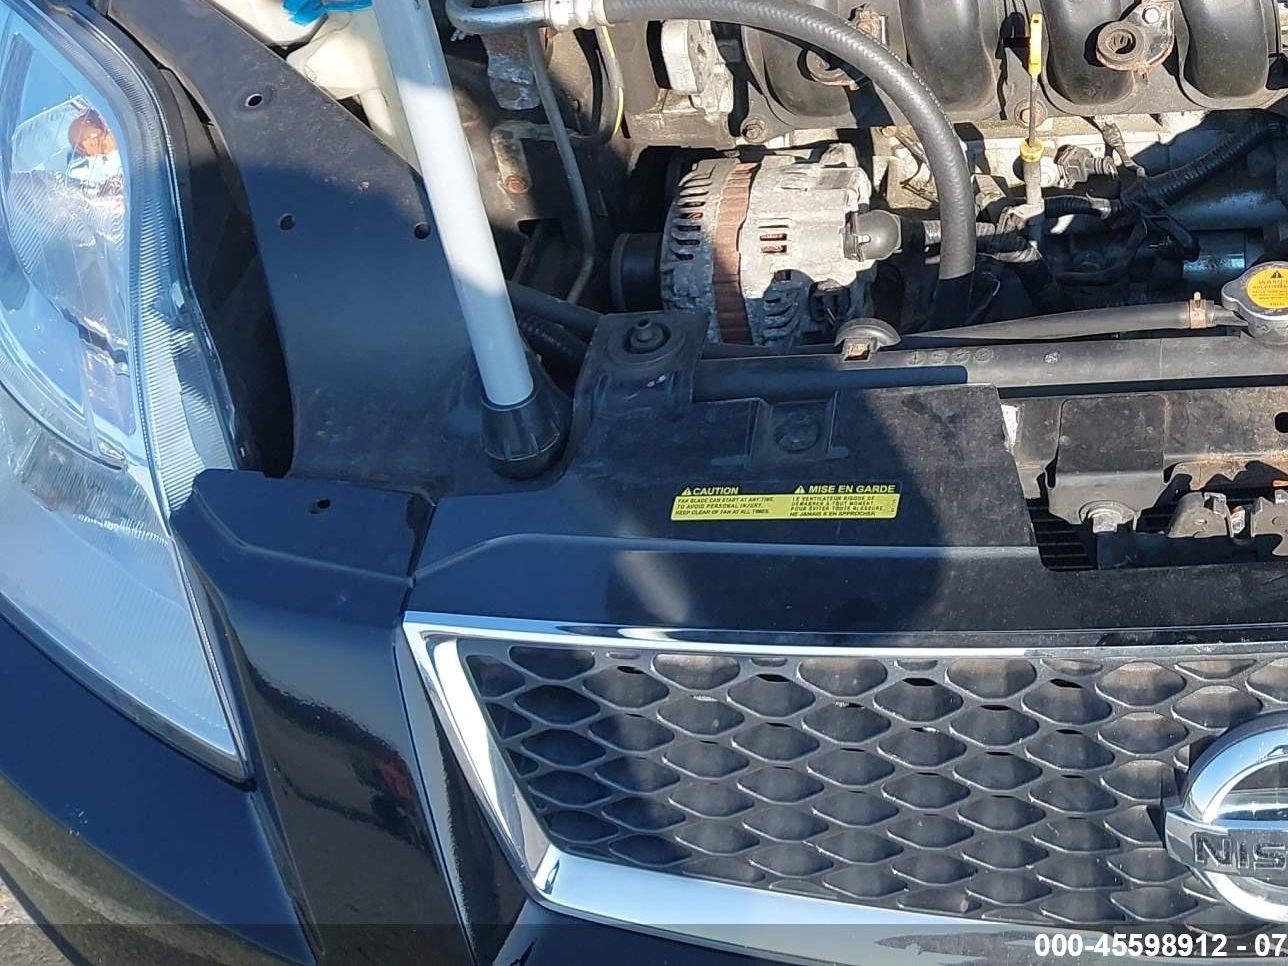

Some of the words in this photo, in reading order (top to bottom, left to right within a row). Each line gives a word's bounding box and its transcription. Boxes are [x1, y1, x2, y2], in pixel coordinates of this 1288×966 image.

[692, 486, 739, 495] CAUTION
[808, 485, 836, 493] MISE
[838, 485, 853, 493] EN
[856, 484, 896, 493] GARDE
